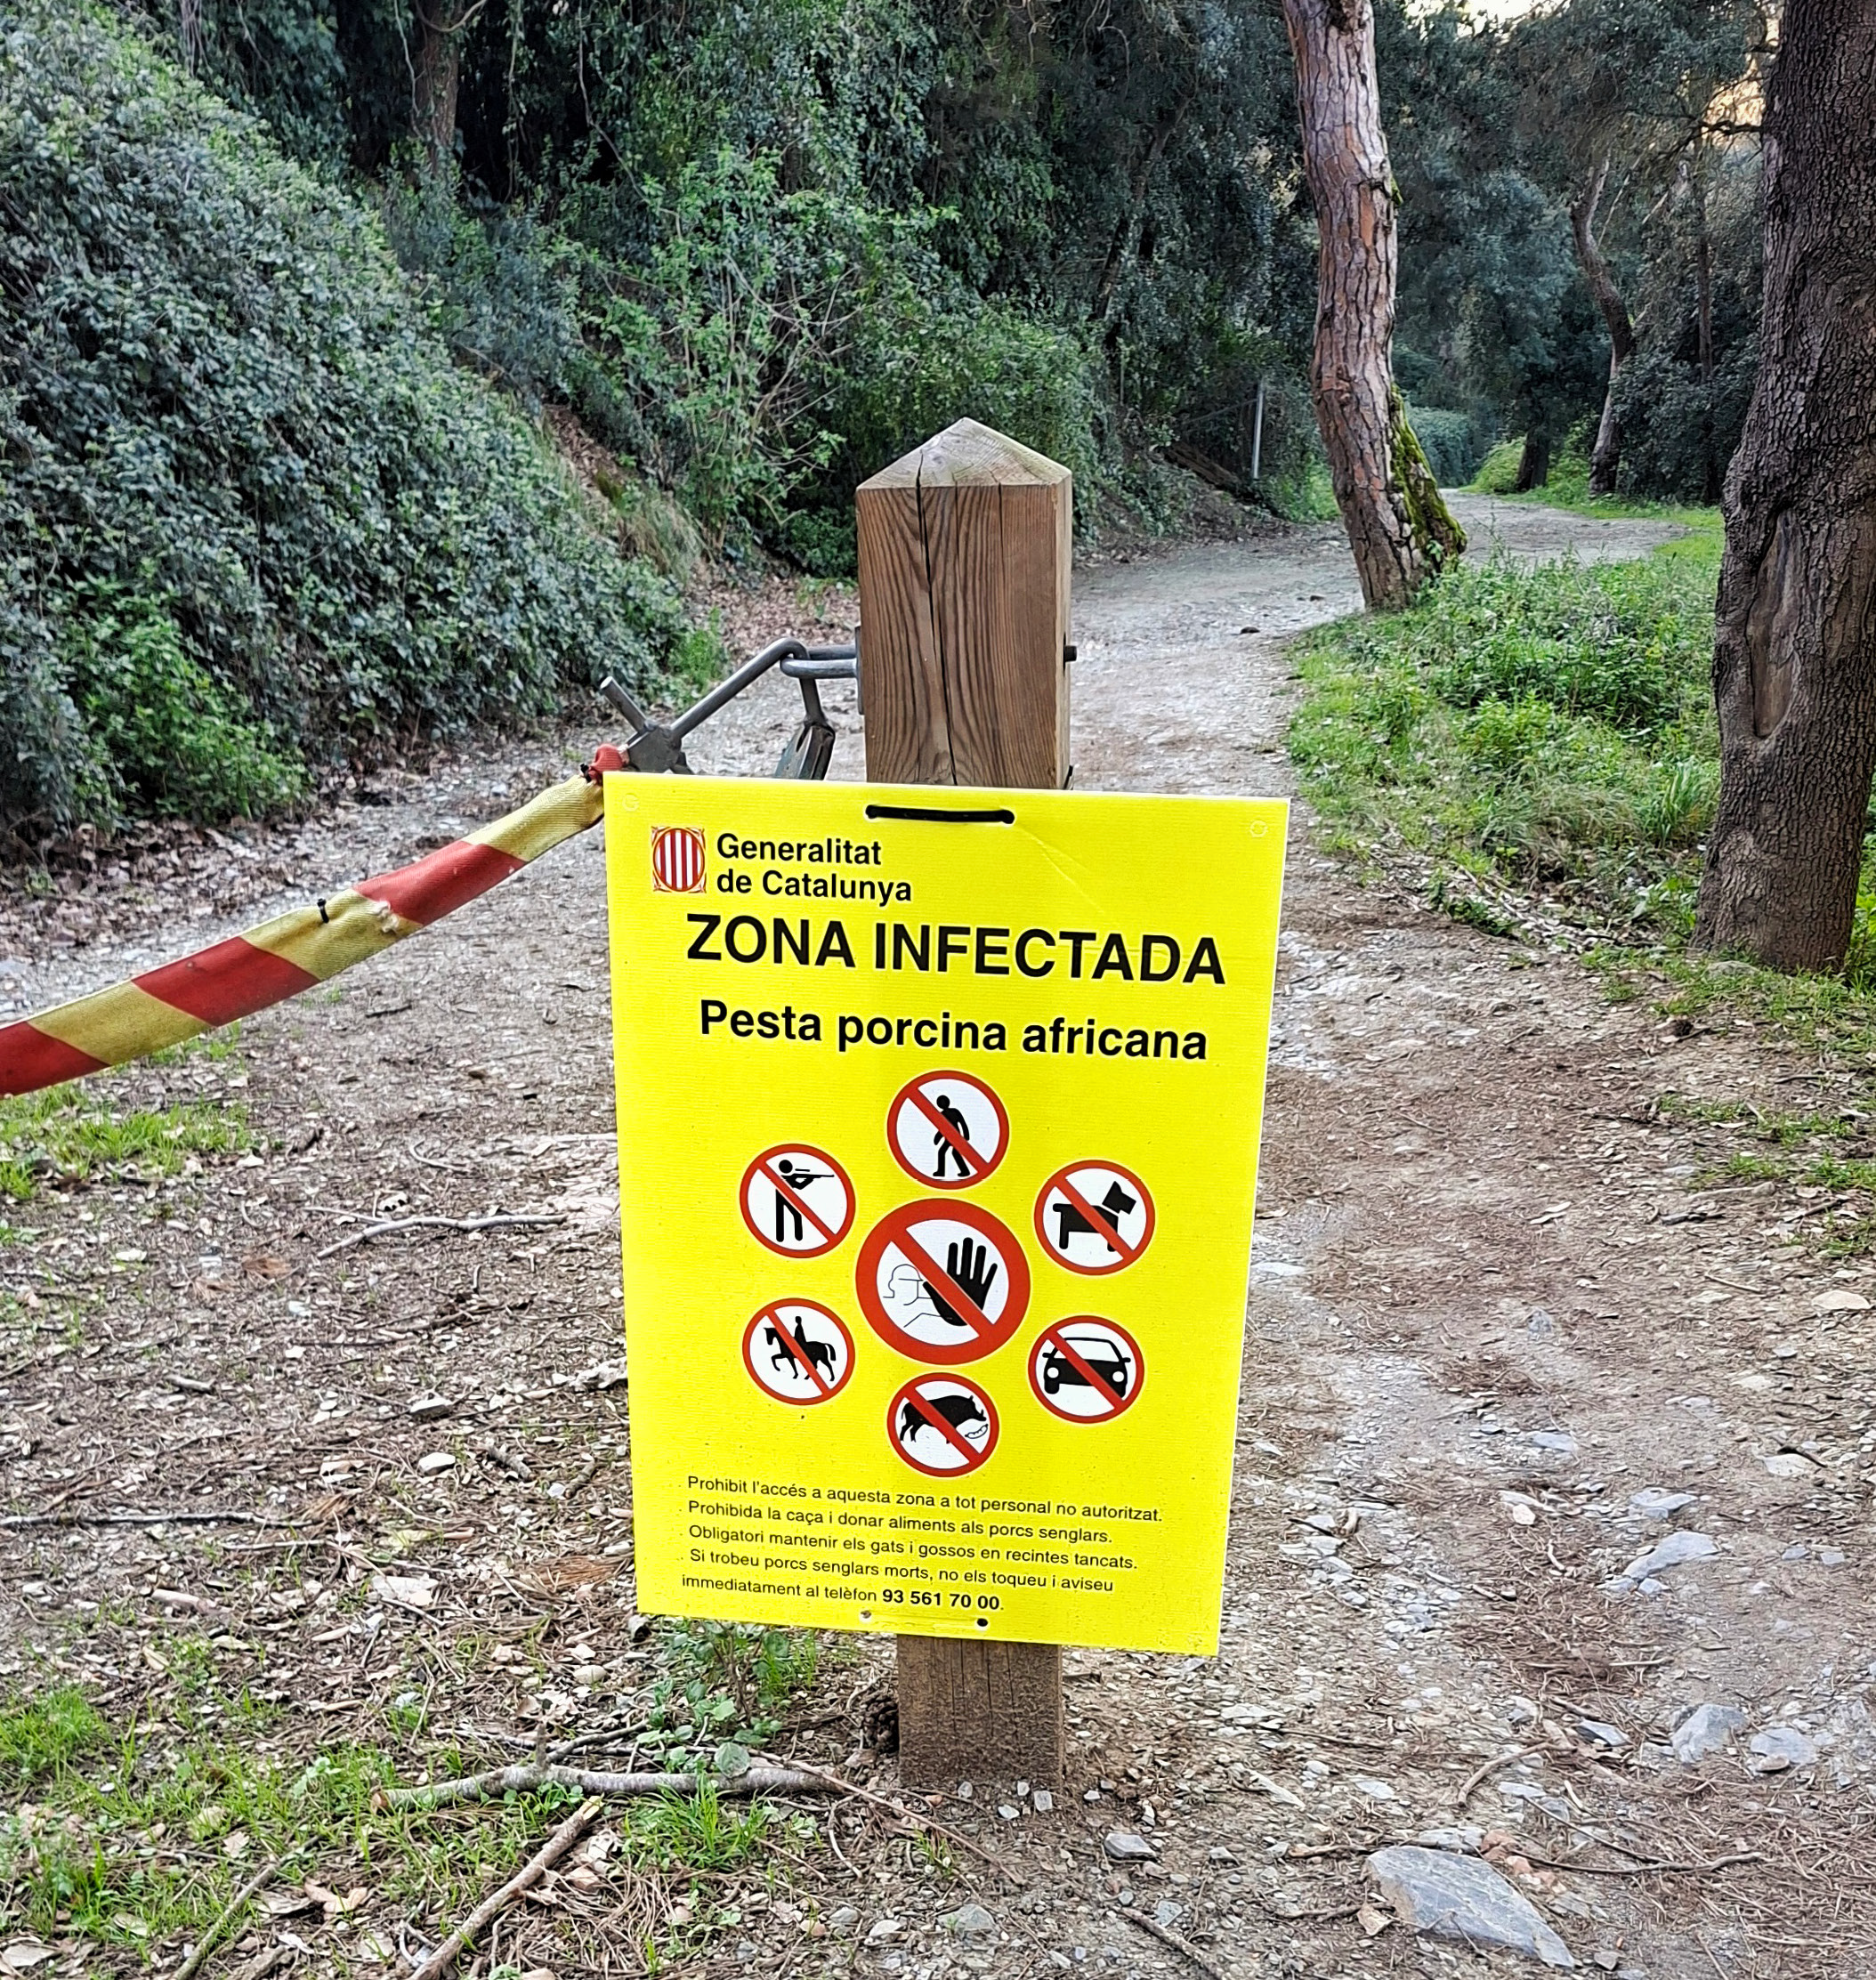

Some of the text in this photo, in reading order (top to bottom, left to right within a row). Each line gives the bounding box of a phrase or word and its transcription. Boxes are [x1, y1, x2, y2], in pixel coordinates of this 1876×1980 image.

[716, 832, 882, 866] Generalitat
[716, 868, 911, 908] de Catalunya
[686, 913, 1225, 985] ZONA INFECTADA
[700, 998, 1207, 1060] Pesta porcina africana
[688, 1475, 1163, 1522] Prohibit l'accés a aquesta zona a tot personal no autoritzat.
[689, 1500, 1113, 1544] Prohibida la caça i donar aliments als porcs senglars.
[689, 1524, 1138, 1570] Obligatori mantenir els gats i gossos en recintes tancats.
[690, 1548, 1113, 1592] Si trobeu porcs senglars morts, no els toqueu i aviseu
[682, 1574, 1005, 1612] immediatament al telèfon 93 561 70 00.
